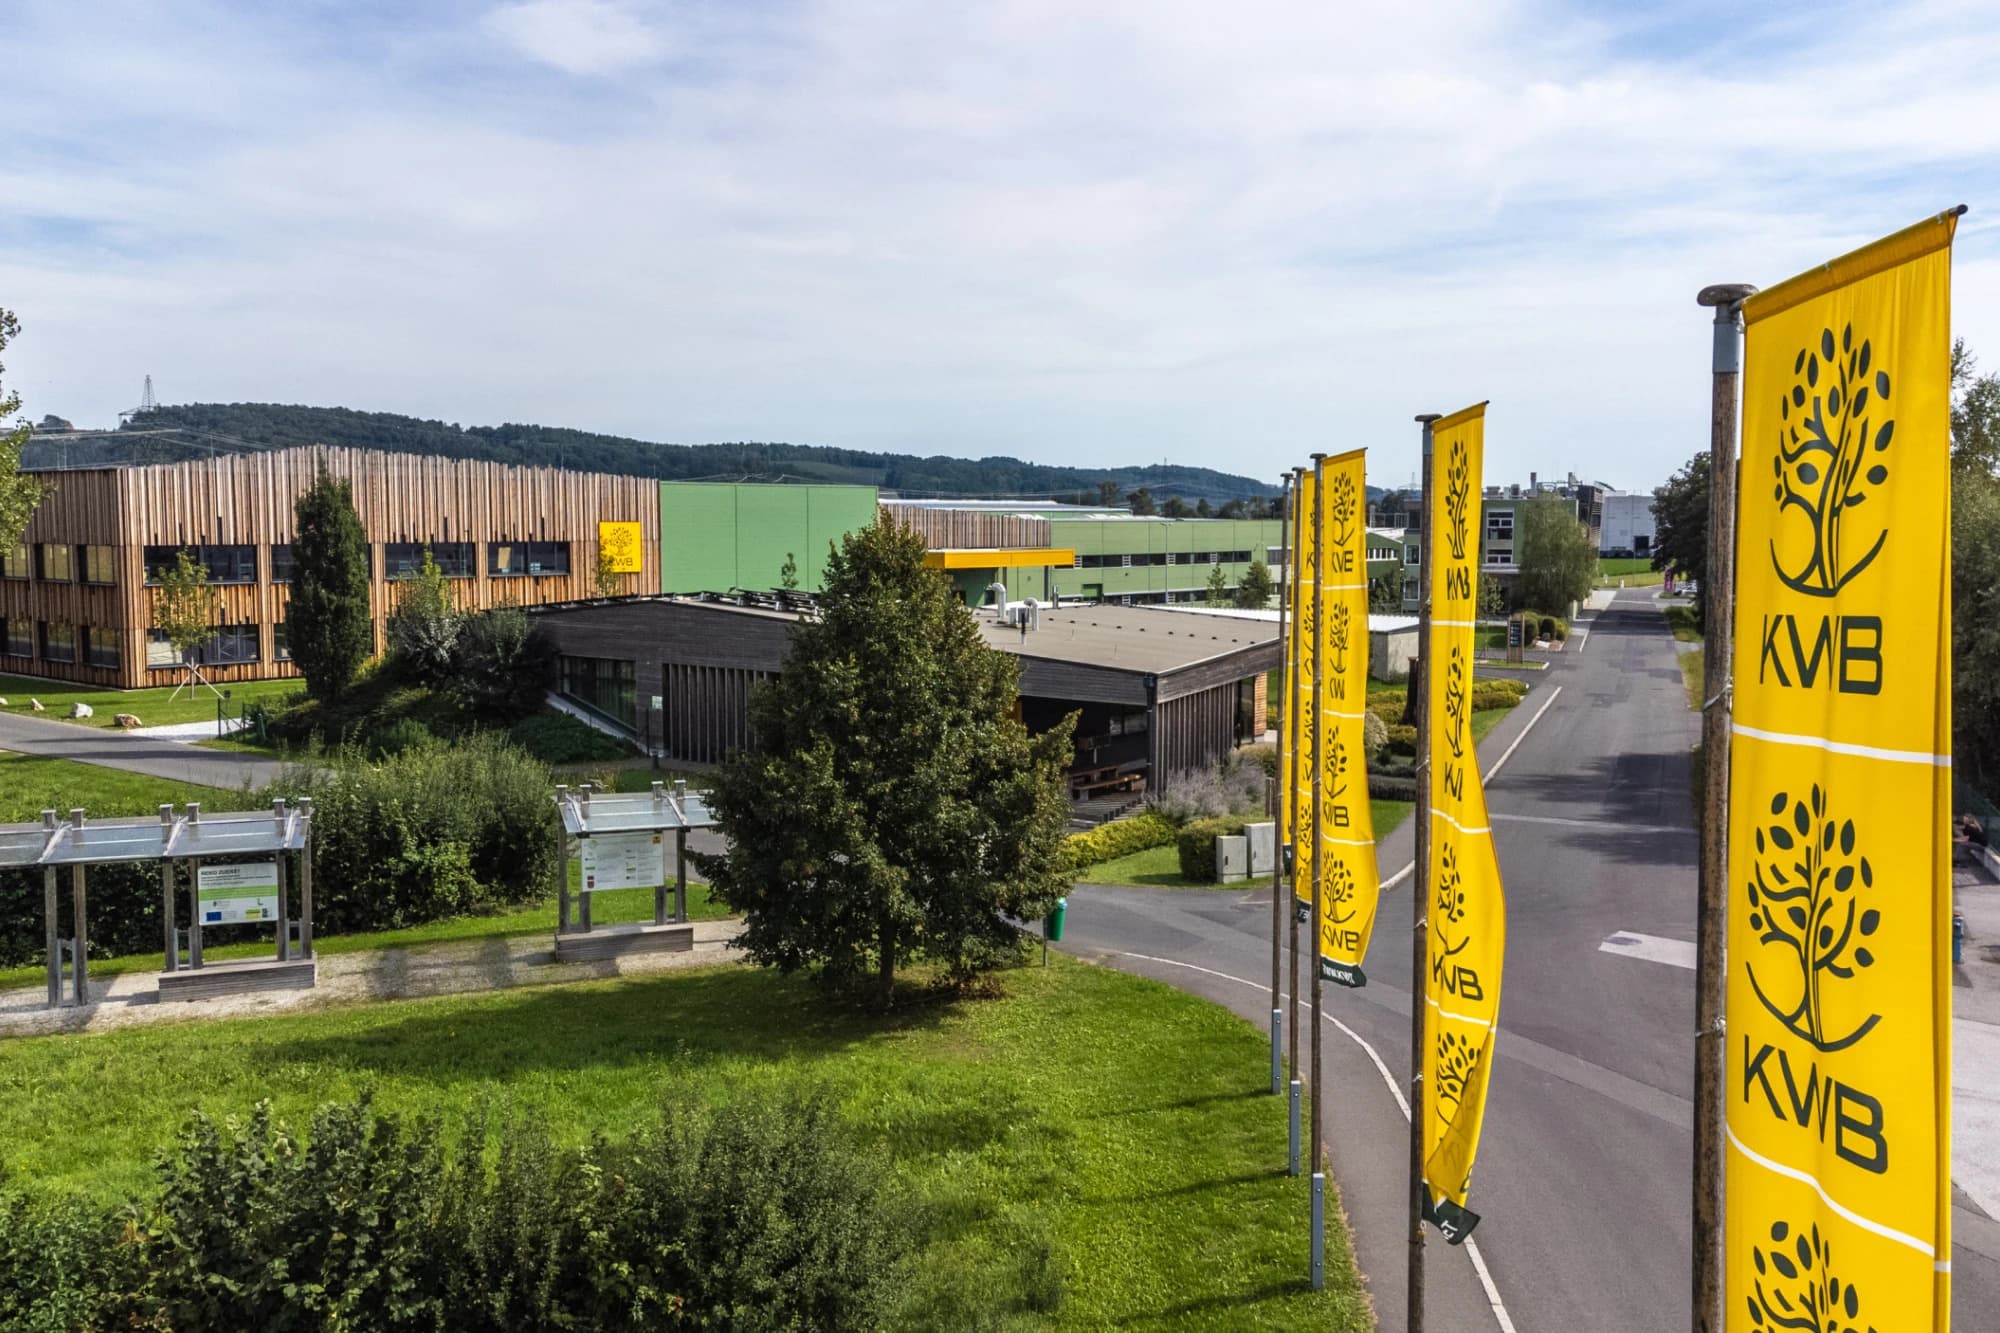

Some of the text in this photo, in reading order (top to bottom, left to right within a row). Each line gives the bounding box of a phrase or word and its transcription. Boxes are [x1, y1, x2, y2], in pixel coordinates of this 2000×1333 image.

[607, 557, 633, 566] WB
[1760, 614, 1883, 696] KWB
[1744, 1034, 1888, 1175] KWB
